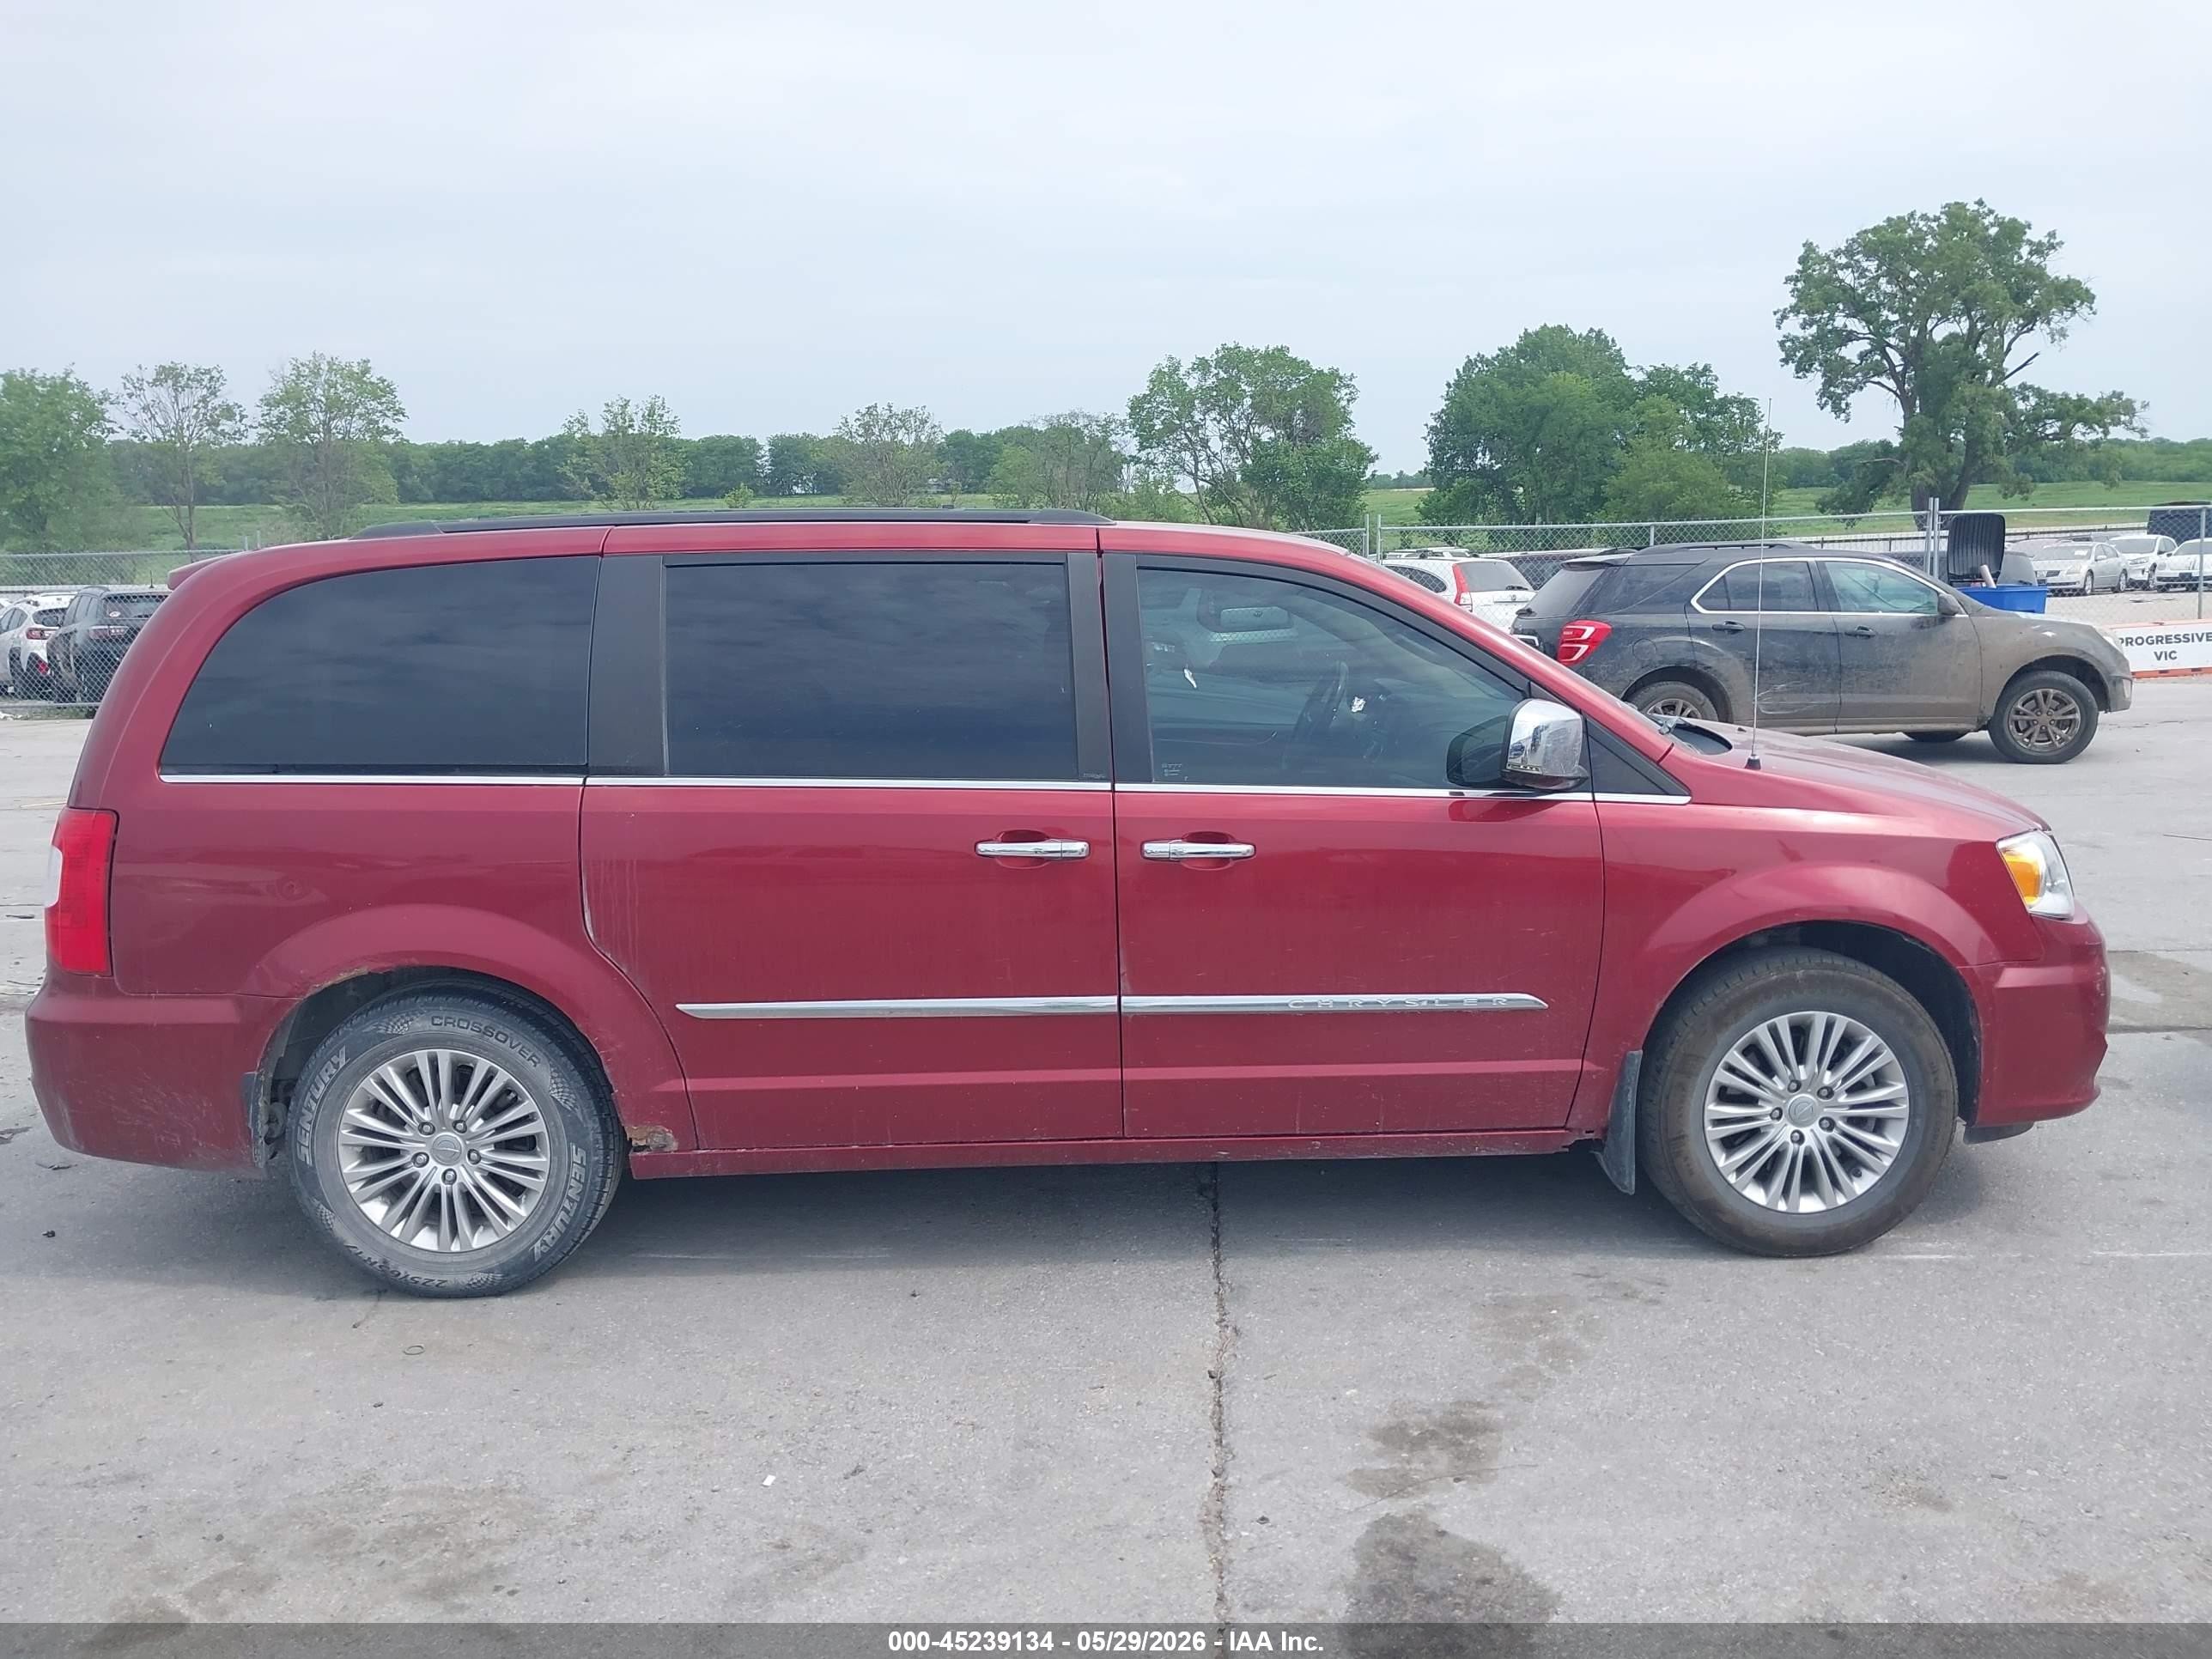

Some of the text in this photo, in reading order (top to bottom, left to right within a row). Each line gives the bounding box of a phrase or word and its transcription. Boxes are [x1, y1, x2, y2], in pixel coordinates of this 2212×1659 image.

[2154, 650, 2178, 661] VIC
[1287, 996, 1510, 1010] CHRYSLER
[430, 1014, 541, 1068] CROSSOVER
[295, 1045, 349, 1167] SENTURY
[528, 1141, 586, 1261] SENTURY
